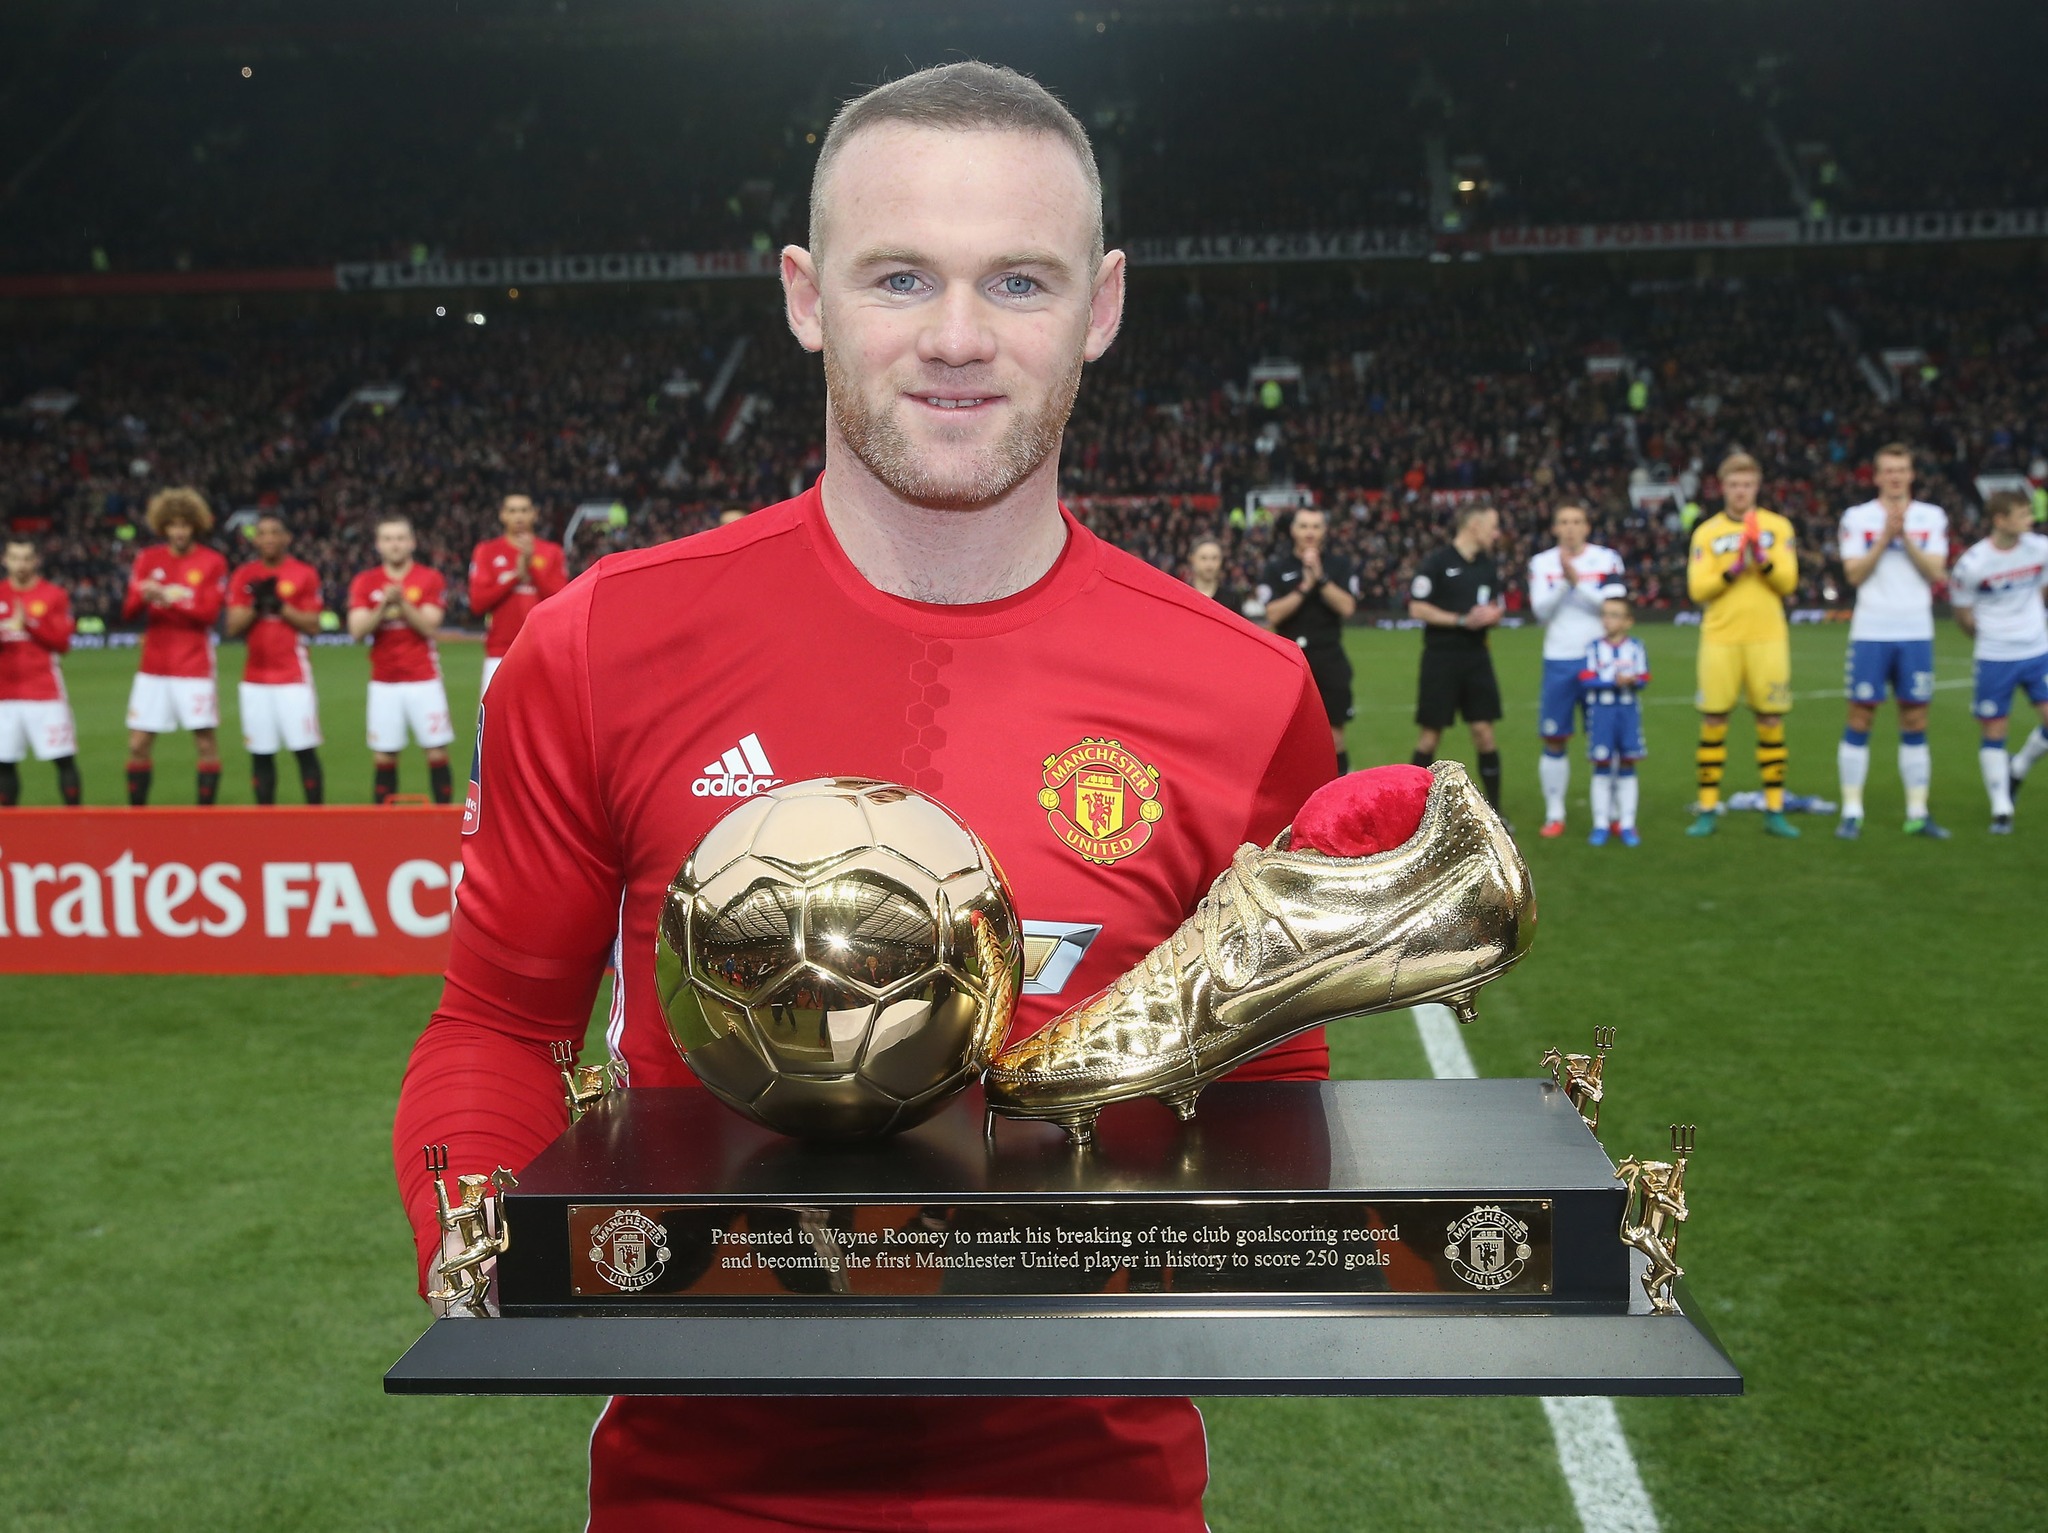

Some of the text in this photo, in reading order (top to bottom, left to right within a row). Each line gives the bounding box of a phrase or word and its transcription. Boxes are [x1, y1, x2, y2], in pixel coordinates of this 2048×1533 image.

[1497, 226, 1581, 247] MADE
[1594, 221, 1747, 245] POSSIBLE
[1051, 747, 1150, 792] MANCHESTER
[691, 772, 784, 797] adida
[1066, 829, 1133, 856] UNITED
[262, 862, 378, 938] FA
[596, 1215, 661, 1243] MANCHESTER
[711, 1224, 1400, 1248] Presented to Wayne Rooney to mark his breaking of the club goalscoring record
[1453, 1211, 1522, 1240] MANCHESTER
[722, 1249, 1390, 1272] and becoming the first Manchester United player in history to score 250 goals
[609, 1271, 654, 1287] UNITED
[1464, 1269, 1513, 1286] UNITED
